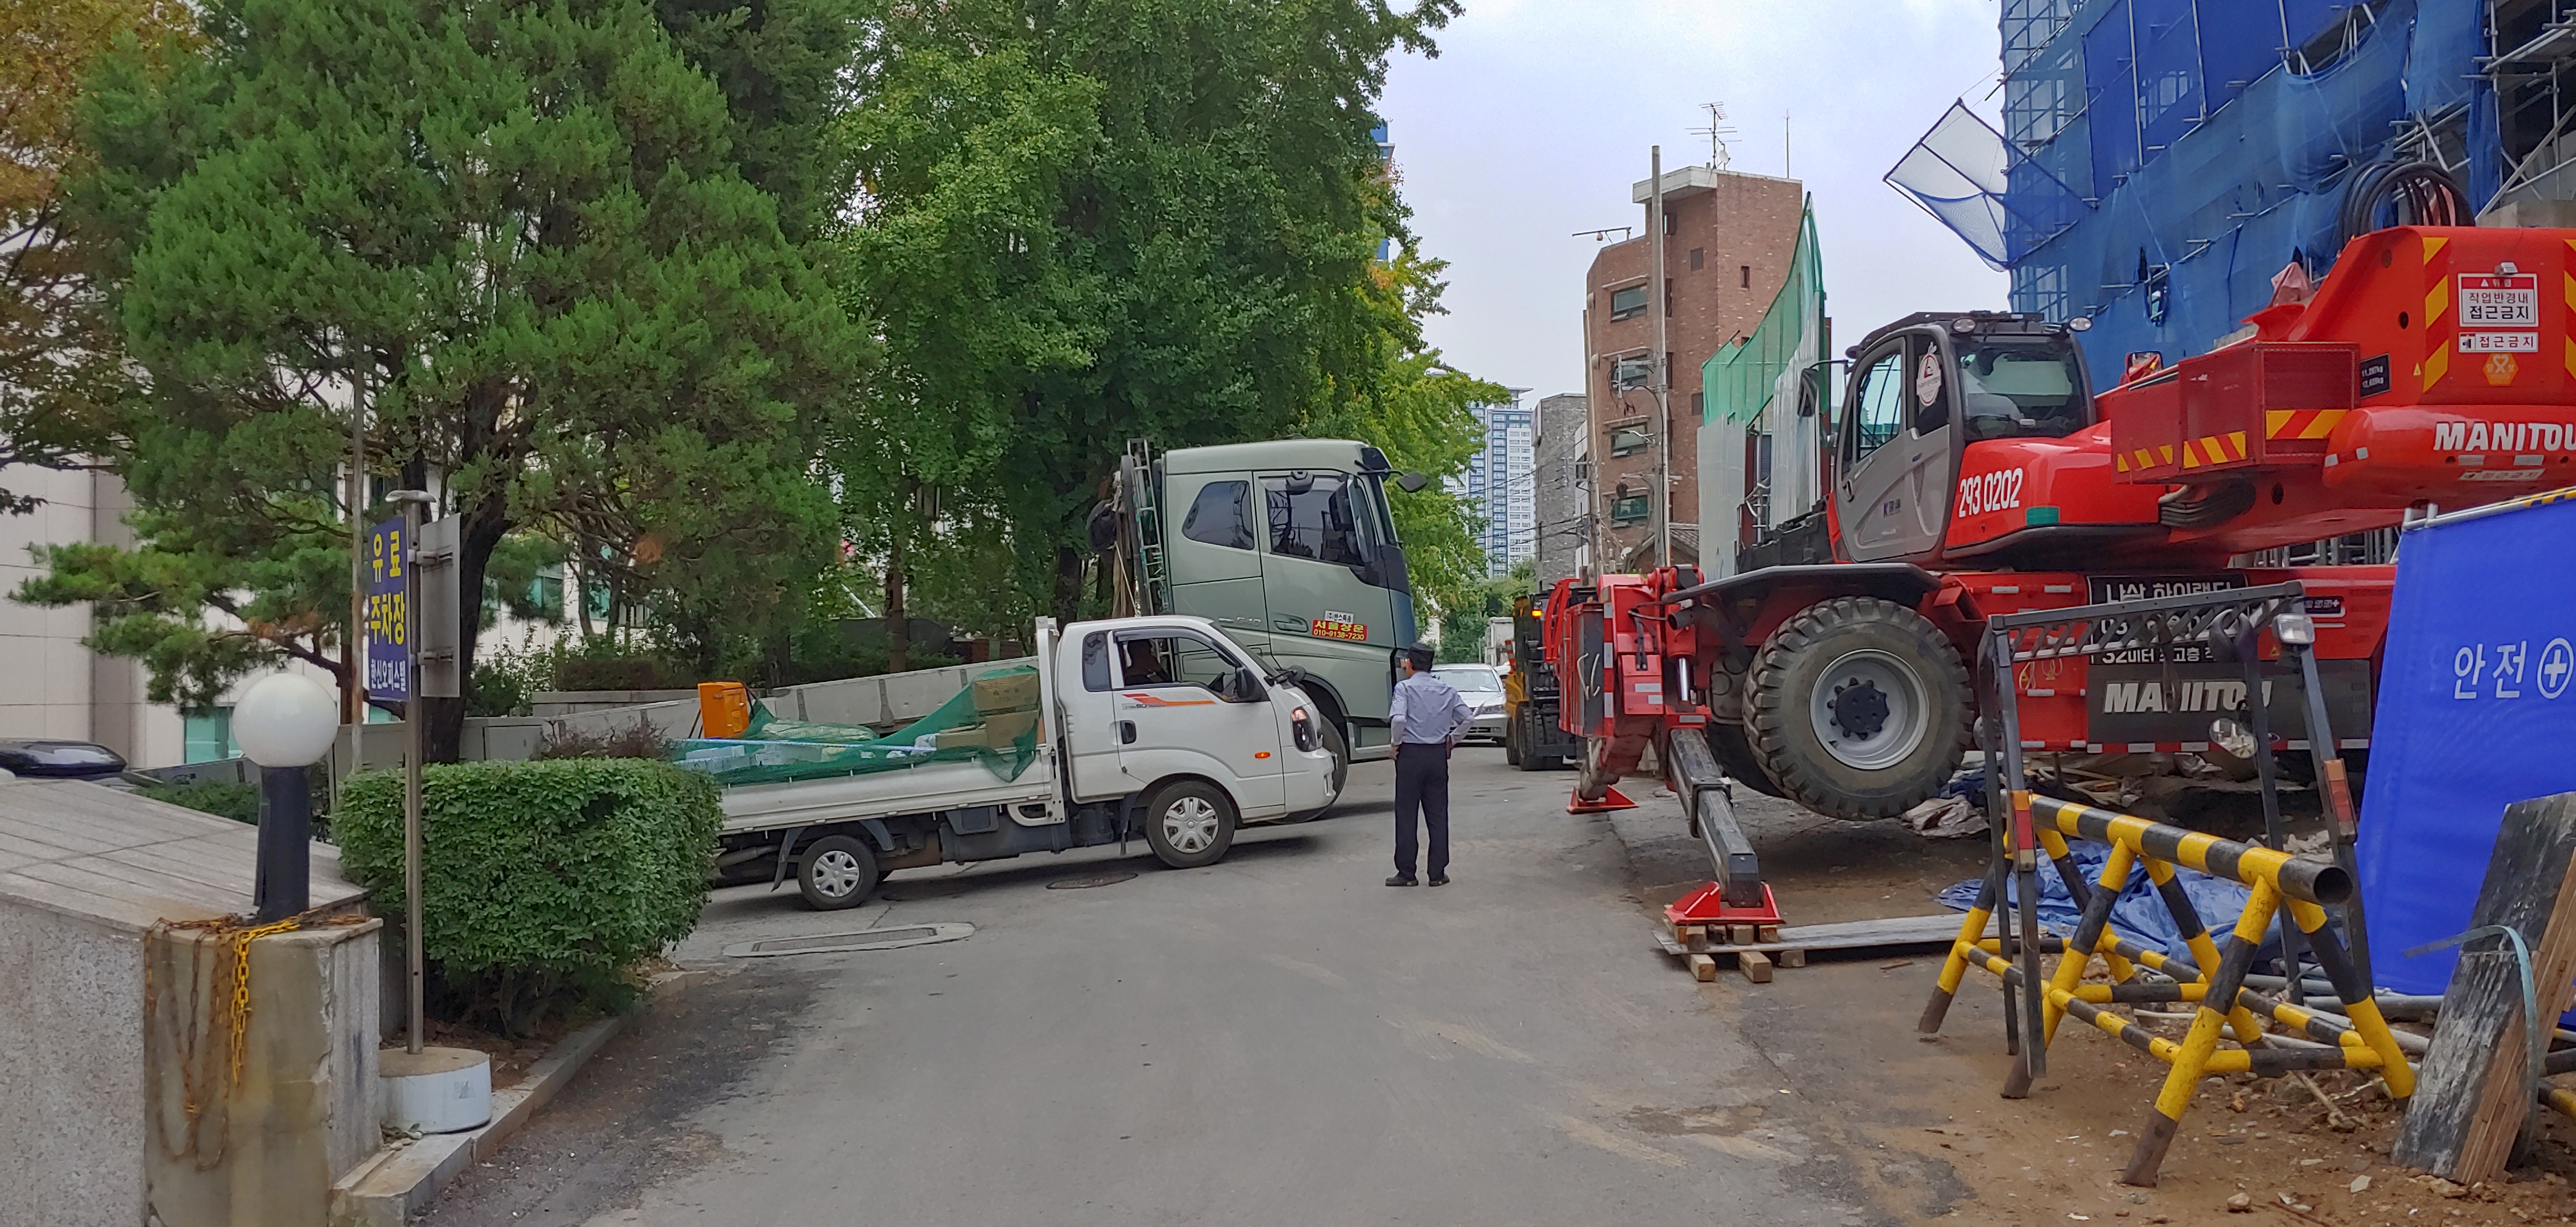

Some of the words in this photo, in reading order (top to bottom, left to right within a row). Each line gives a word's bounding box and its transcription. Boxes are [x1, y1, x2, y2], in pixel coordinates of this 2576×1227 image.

[2469, 292, 2528, 304] 작업반경내
[2470, 305, 2529, 319] 접근금지
[2479, 336, 2533, 348] 접근금지
[2433, 422, 2576, 451] MANITOU
[1959, 475, 1982, 517] 293
[1983, 468, 2023, 512] 0202
[372, 530, 402, 583] 유료
[370, 591, 405, 645] 주차장
[371, 658, 406, 692] 한신오피스텔
[2454, 640, 2527, 699] 안전
